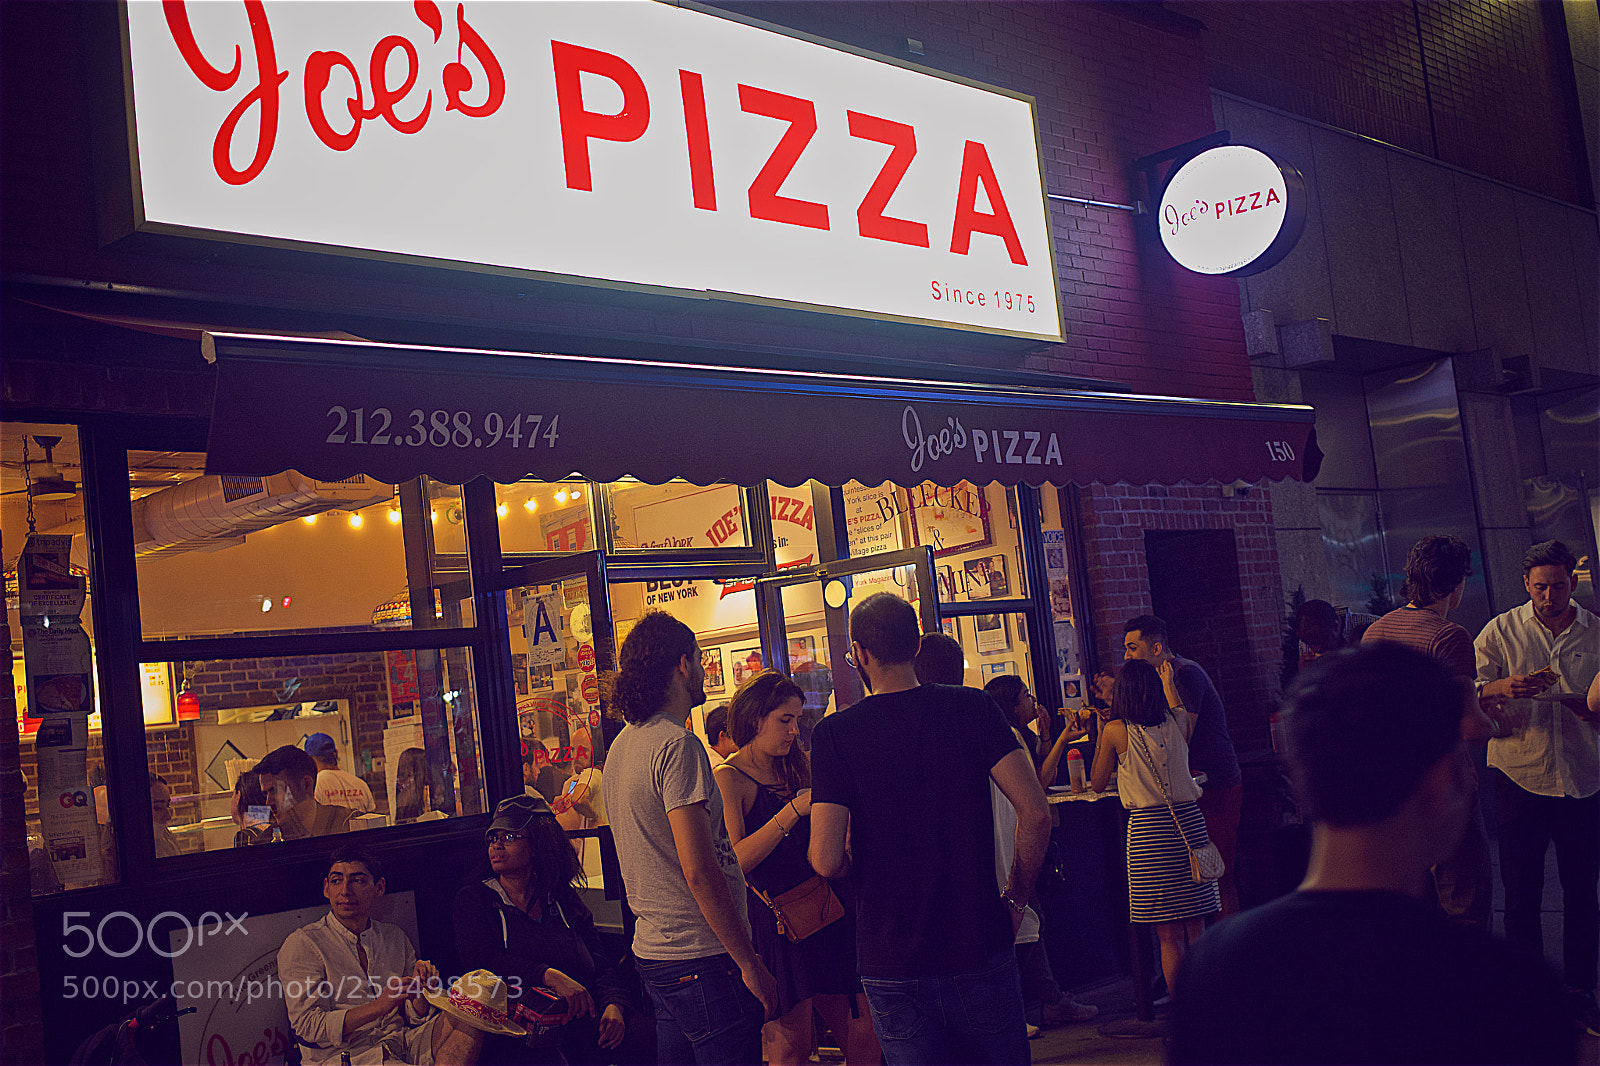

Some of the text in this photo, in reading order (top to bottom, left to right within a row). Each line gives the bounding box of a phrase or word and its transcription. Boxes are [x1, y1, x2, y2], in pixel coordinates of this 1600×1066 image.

[162, 0, 1028, 266] Joe's PIZZA
[1165, 188, 1280, 236] Joe's PIZZA
[931, 280, 1035, 314] Since 1975
[326, 405, 560, 449] 212.388.9474
[902, 405, 1063, 472] Joe's PIZZA
[1265, 440, 1295, 462] 150
[862, 494, 878, 502] slice
[875, 483, 991, 524] BLEECKER
[770, 496, 814, 531] IZZA
[847, 516, 859, 526] E'S
[705, 505, 742, 547] JOE'
[36, 537, 71, 547] tripadvis
[870, 544, 887, 554] pizza
[869, 574, 892, 585] Magazin
[647, 586, 698, 605] OF NEW YORK
[533, 600, 558, 646] A
[534, 745, 588, 764] PIZZA
[60, 791, 88, 808] GQ
[248, 960, 279, 982] Green
